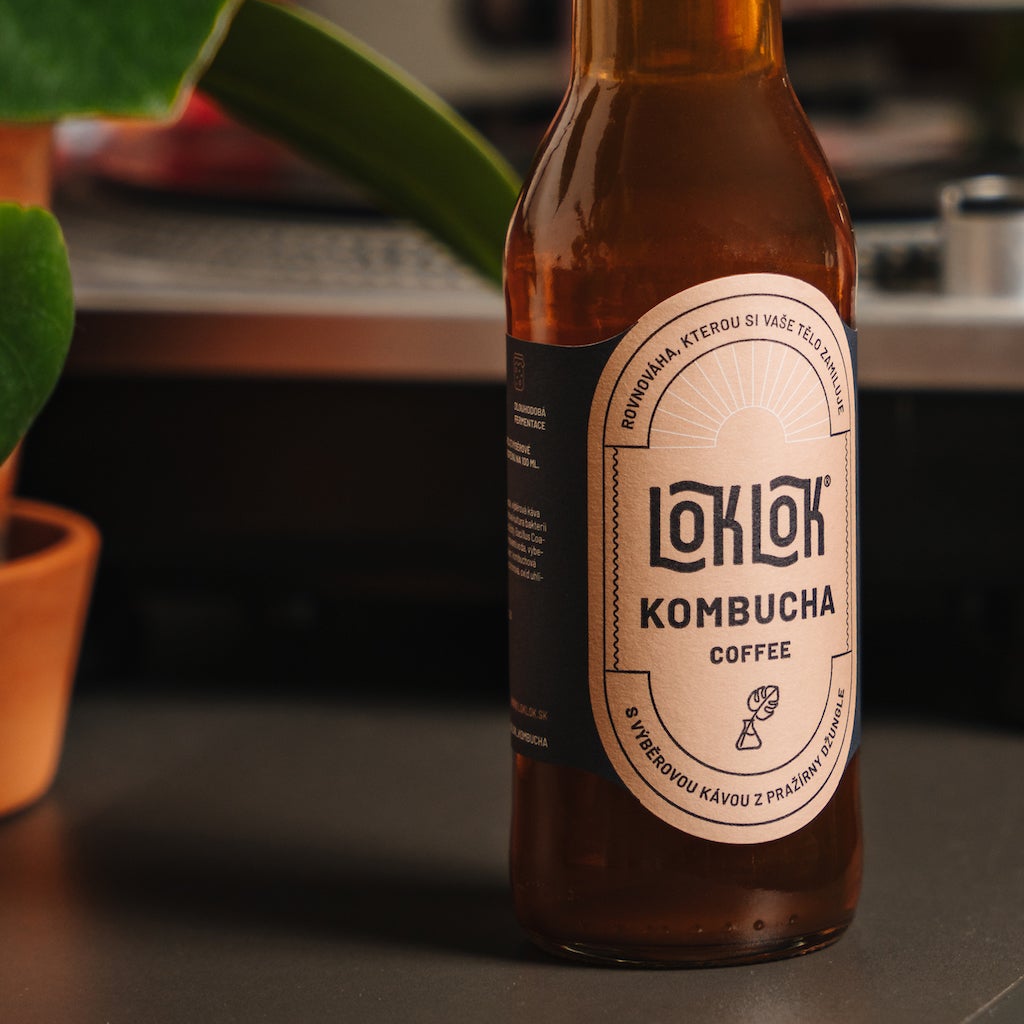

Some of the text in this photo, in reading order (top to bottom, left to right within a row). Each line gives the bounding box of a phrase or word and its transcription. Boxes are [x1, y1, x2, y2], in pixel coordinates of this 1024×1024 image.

[621, 314, 845, 430] ROVNOVÁHA, KTEROU SI VAŠE TĚLO ZAMILUJE
[640, 585, 836, 629] KOMBUCHA
[709, 640, 792, 665] COFFEE
[625, 687, 845, 807] S VÝBĚROVOU KÁVOU Z PRAŽÍRNY DŽUNGLE
